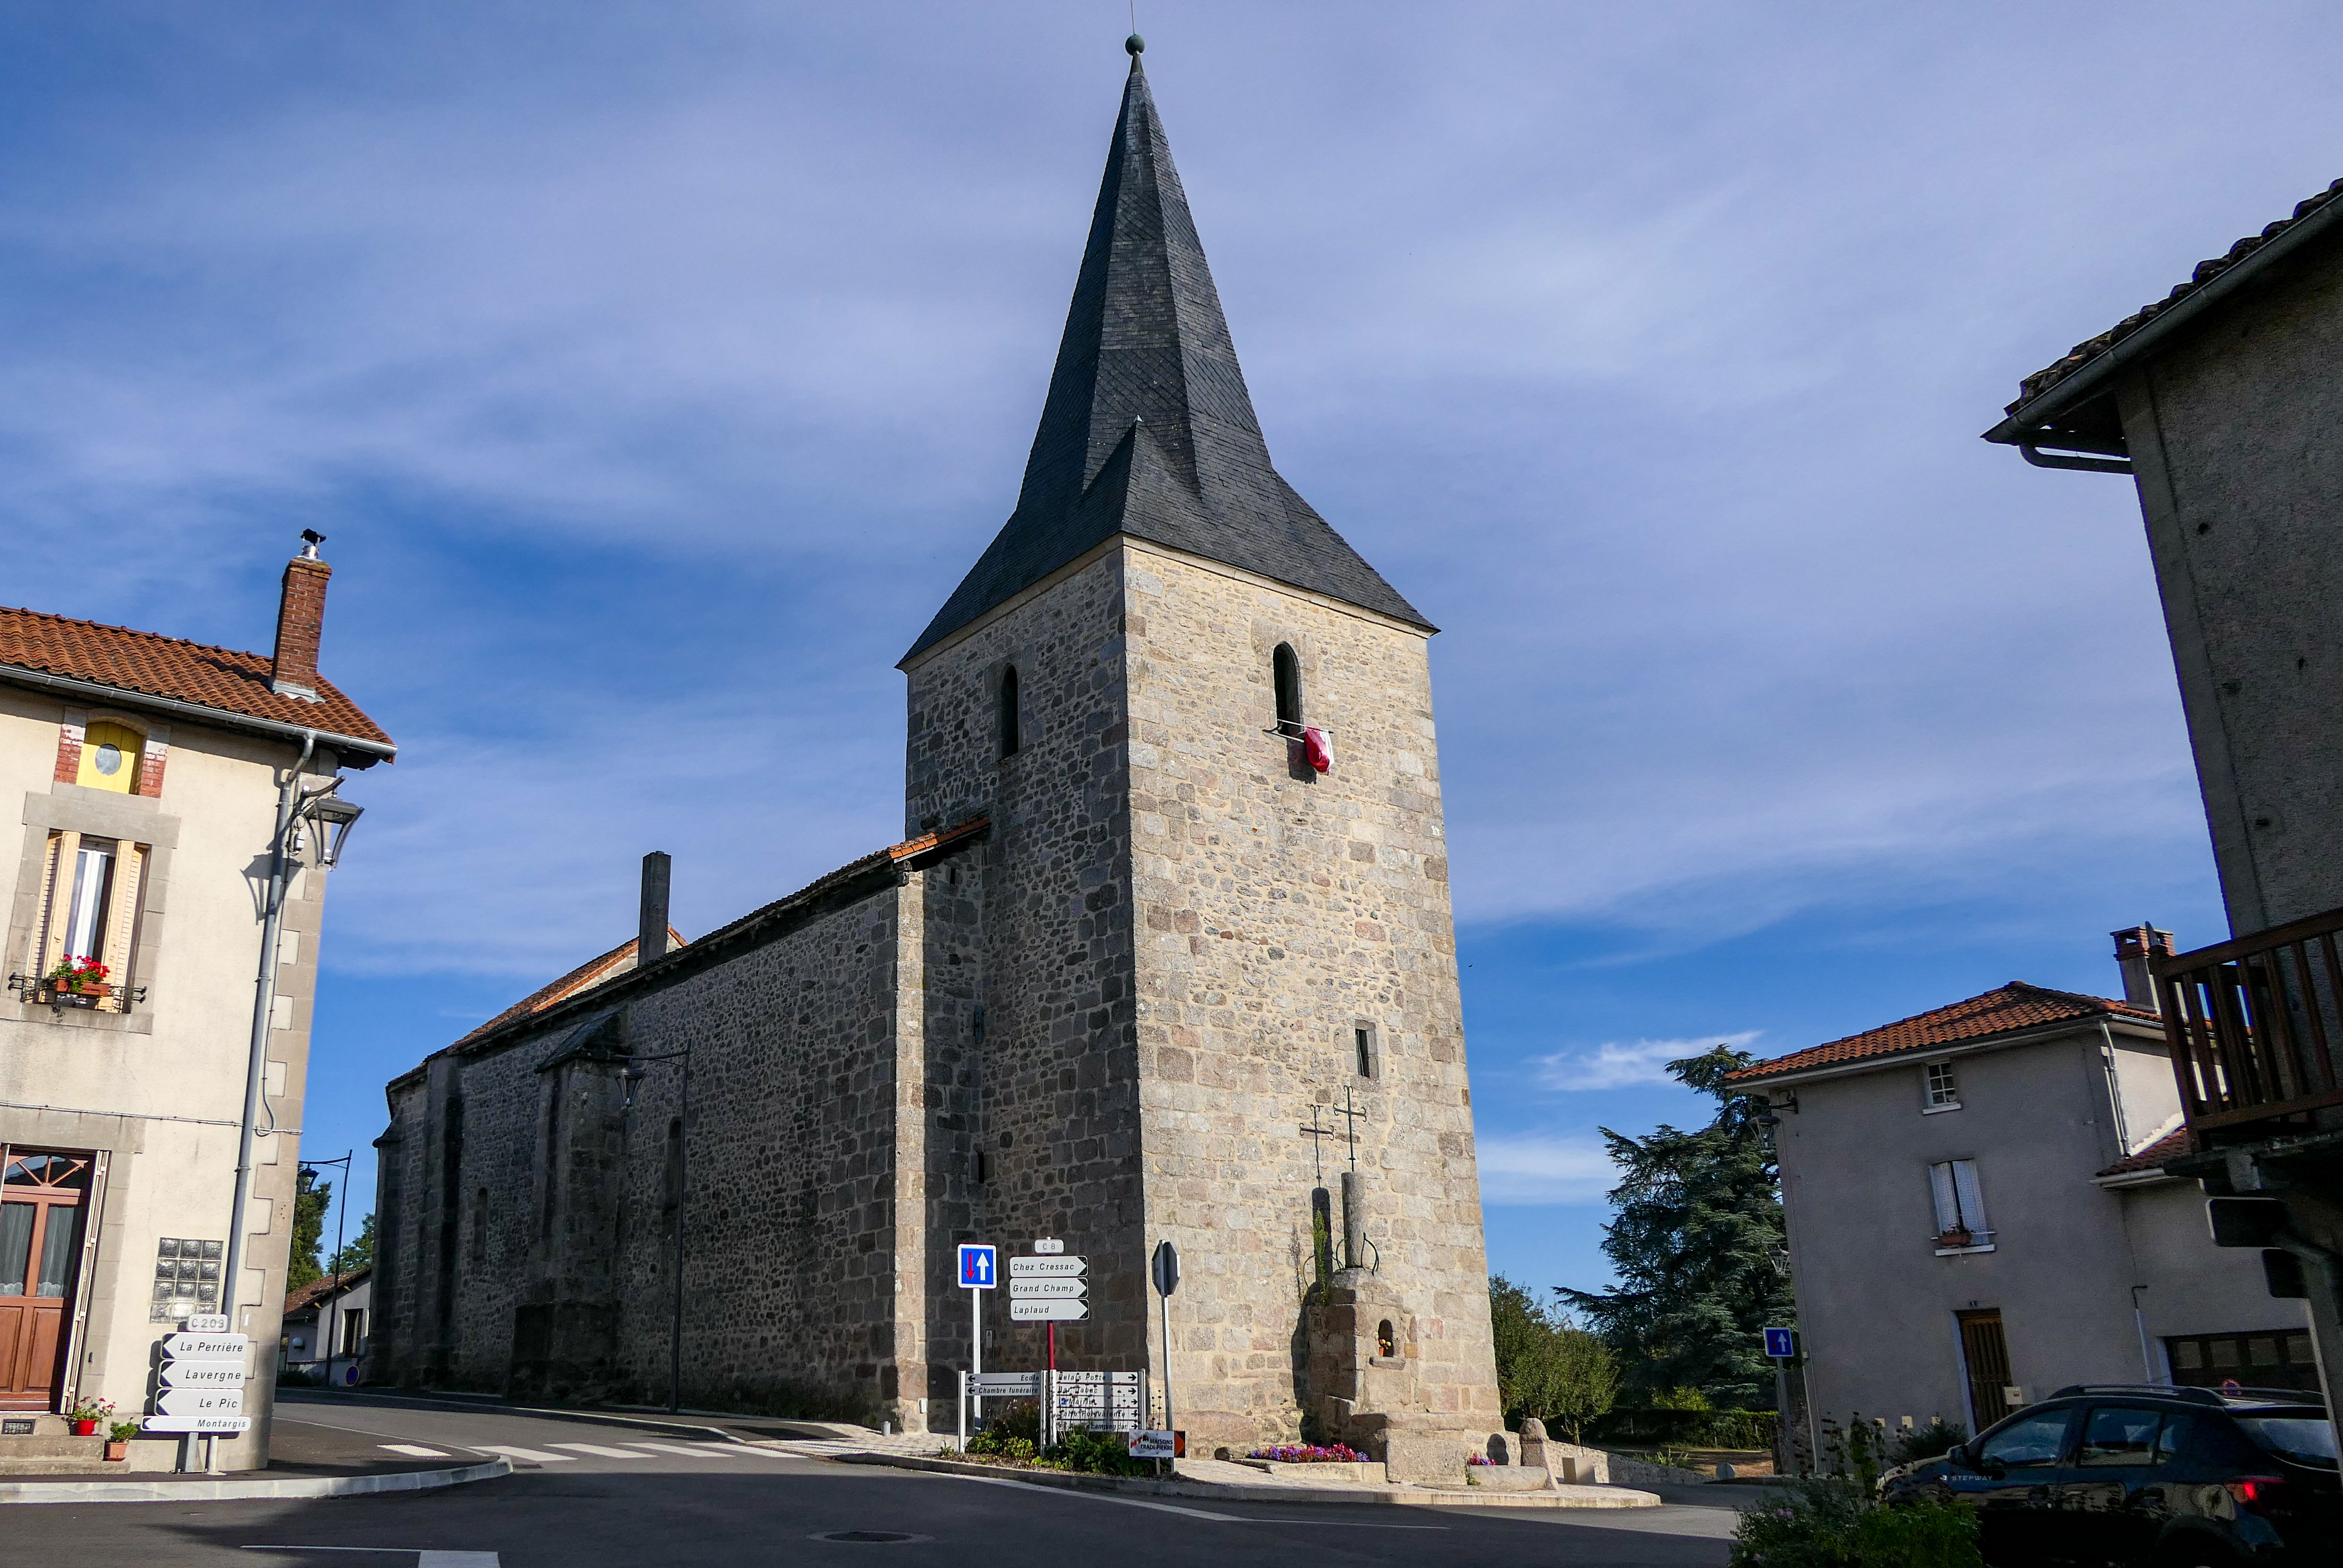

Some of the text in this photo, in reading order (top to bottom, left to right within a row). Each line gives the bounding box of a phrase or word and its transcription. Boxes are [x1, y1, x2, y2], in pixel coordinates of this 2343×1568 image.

[1044, 1284, 1074, 1293] Champ
[1014, 1305, 1049, 1315] Laplaud
[180, 1341, 243, 1352] La Perrière
[186, 1369, 241, 1382] Lavergne
[199, 1398, 237, 1408] Le Pic
[198, 1419, 246, 1430] Montargis
